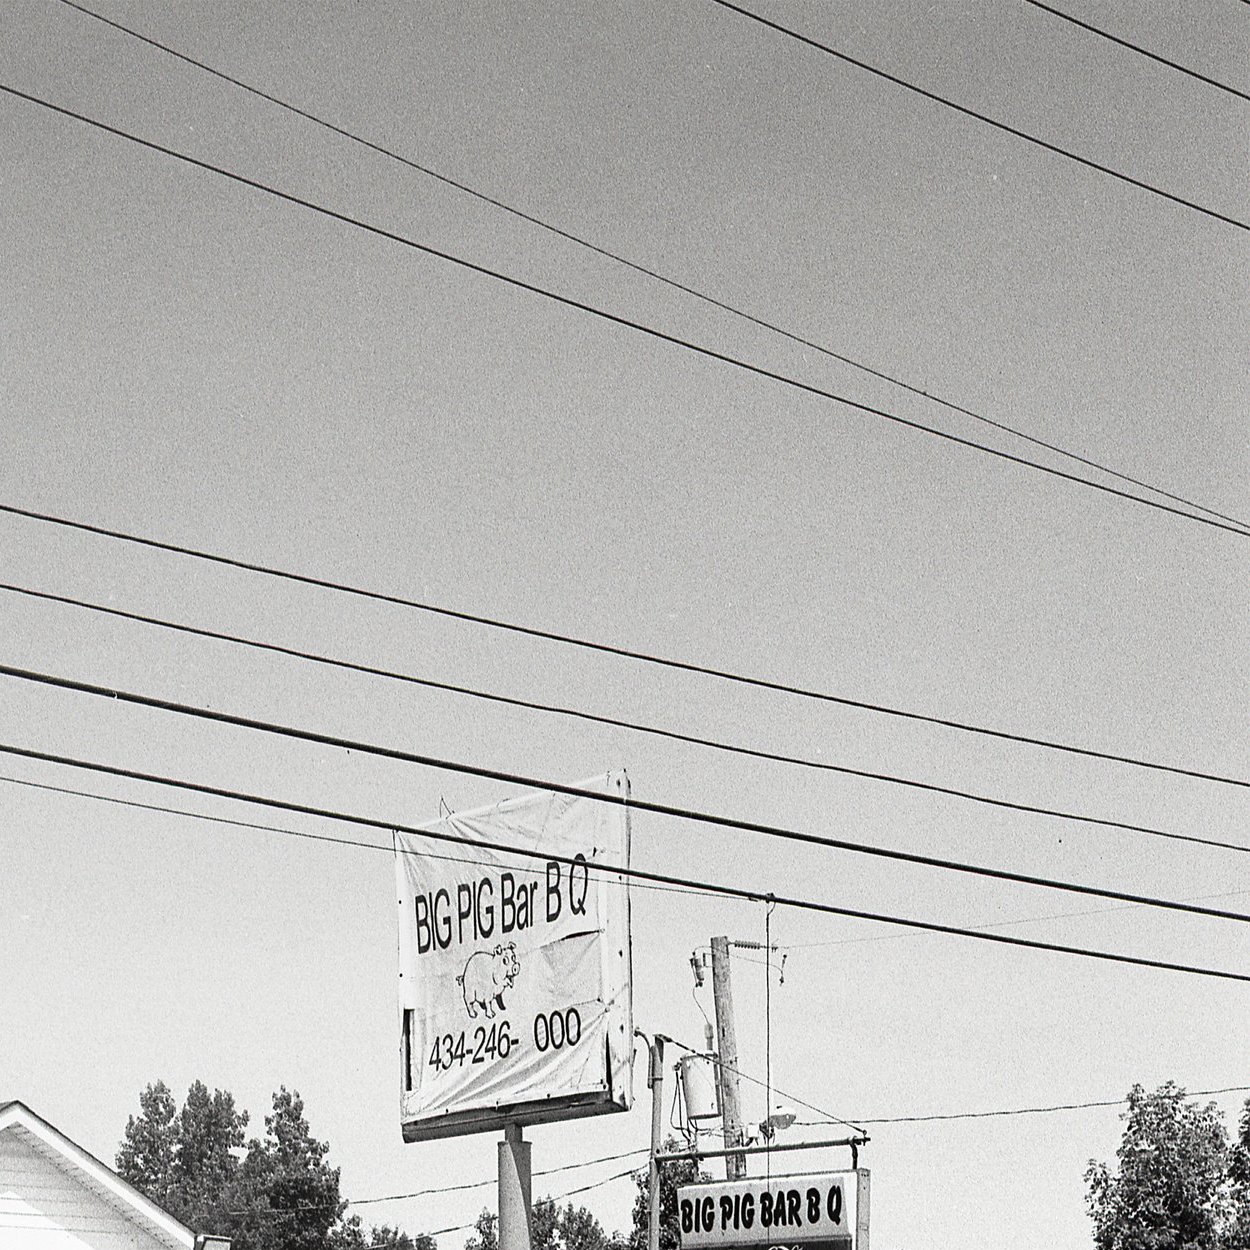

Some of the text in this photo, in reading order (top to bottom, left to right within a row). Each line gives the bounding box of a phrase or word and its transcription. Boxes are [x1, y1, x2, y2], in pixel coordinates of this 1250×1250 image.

[415, 853, 588, 954] BIG PIG Bar B Q
[534, 1007, 582, 1051] 000
[680, 1185, 842, 1234] BIG PIG BAR B Q
